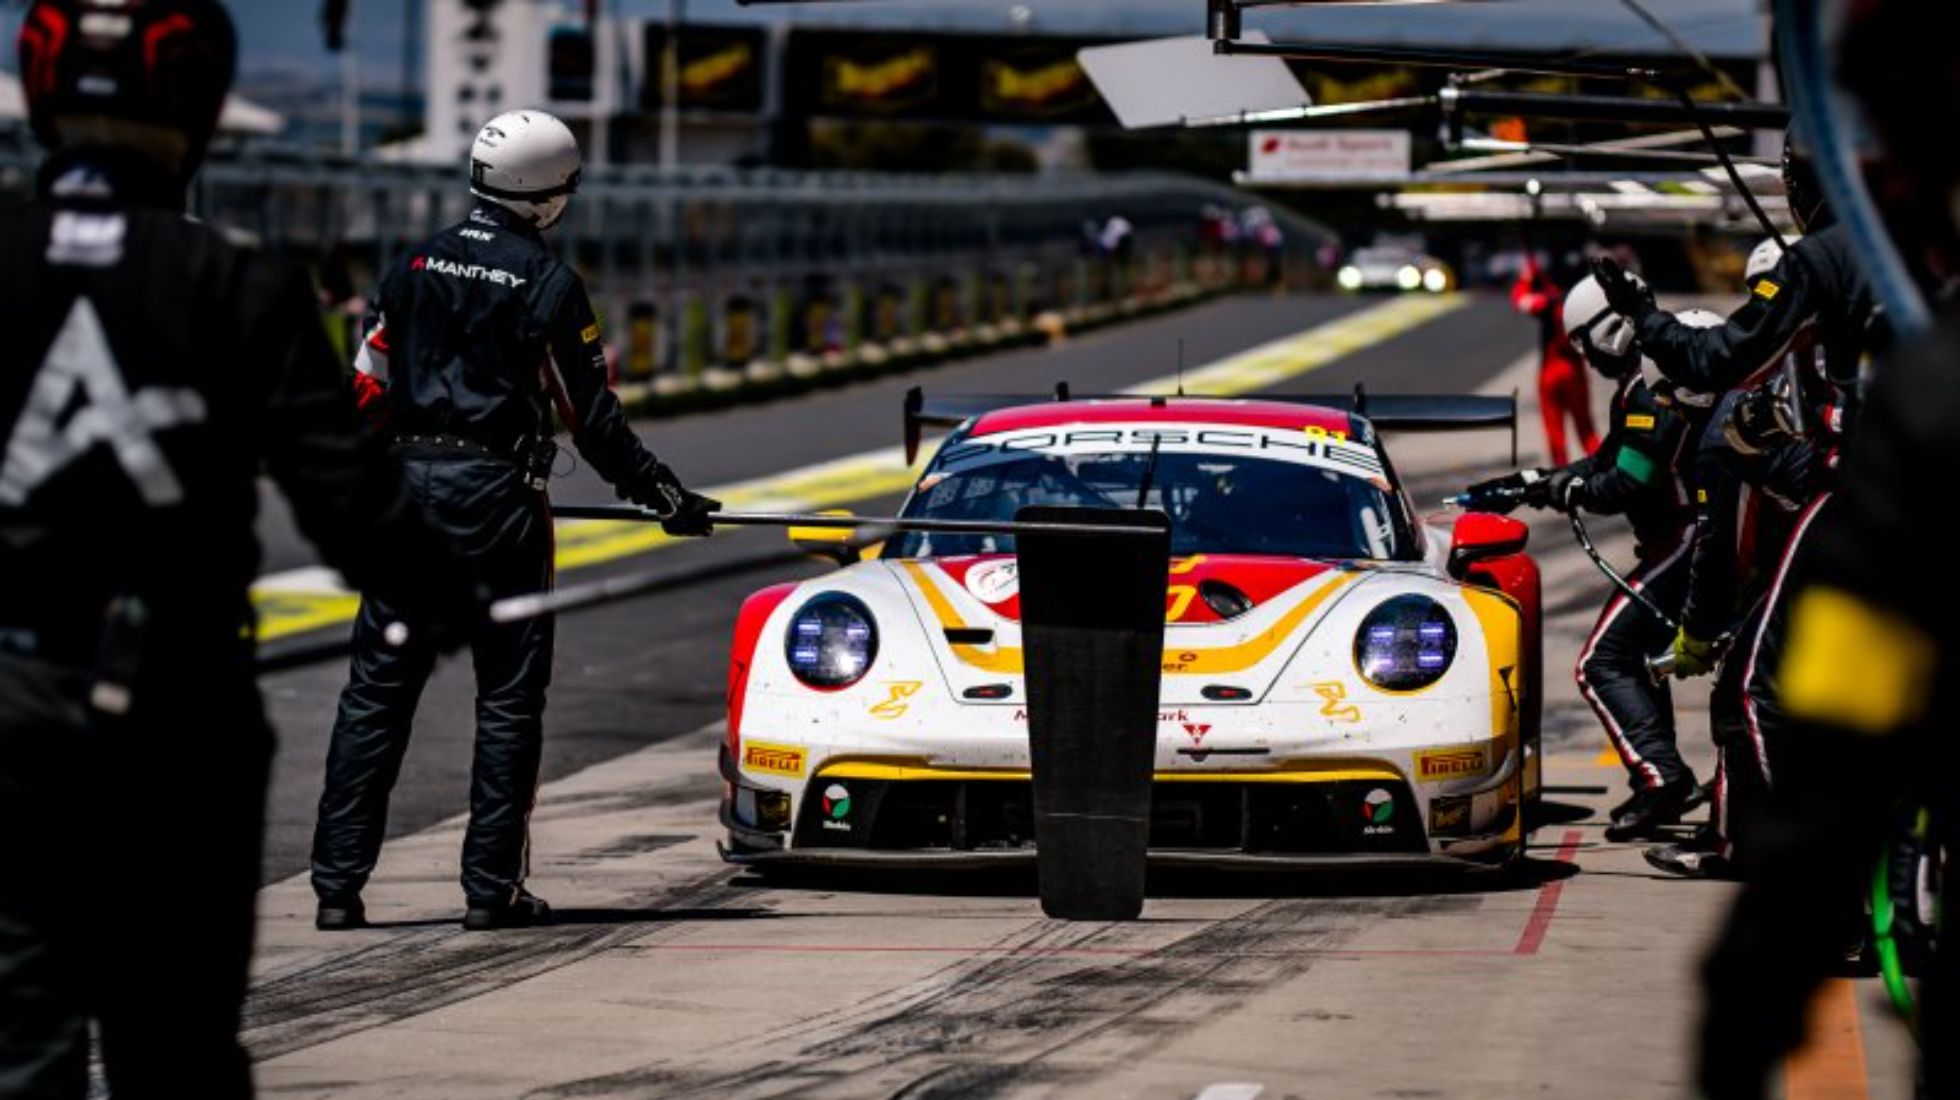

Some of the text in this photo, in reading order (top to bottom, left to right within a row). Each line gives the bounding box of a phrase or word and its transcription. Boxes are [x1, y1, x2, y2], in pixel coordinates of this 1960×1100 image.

[425, 255, 527, 288] MANTHEY
[940, 428, 1383, 475] PORSCHE
[745, 746, 802, 773] PIRELLI
[1420, 751, 1484, 777] PIRELLI
